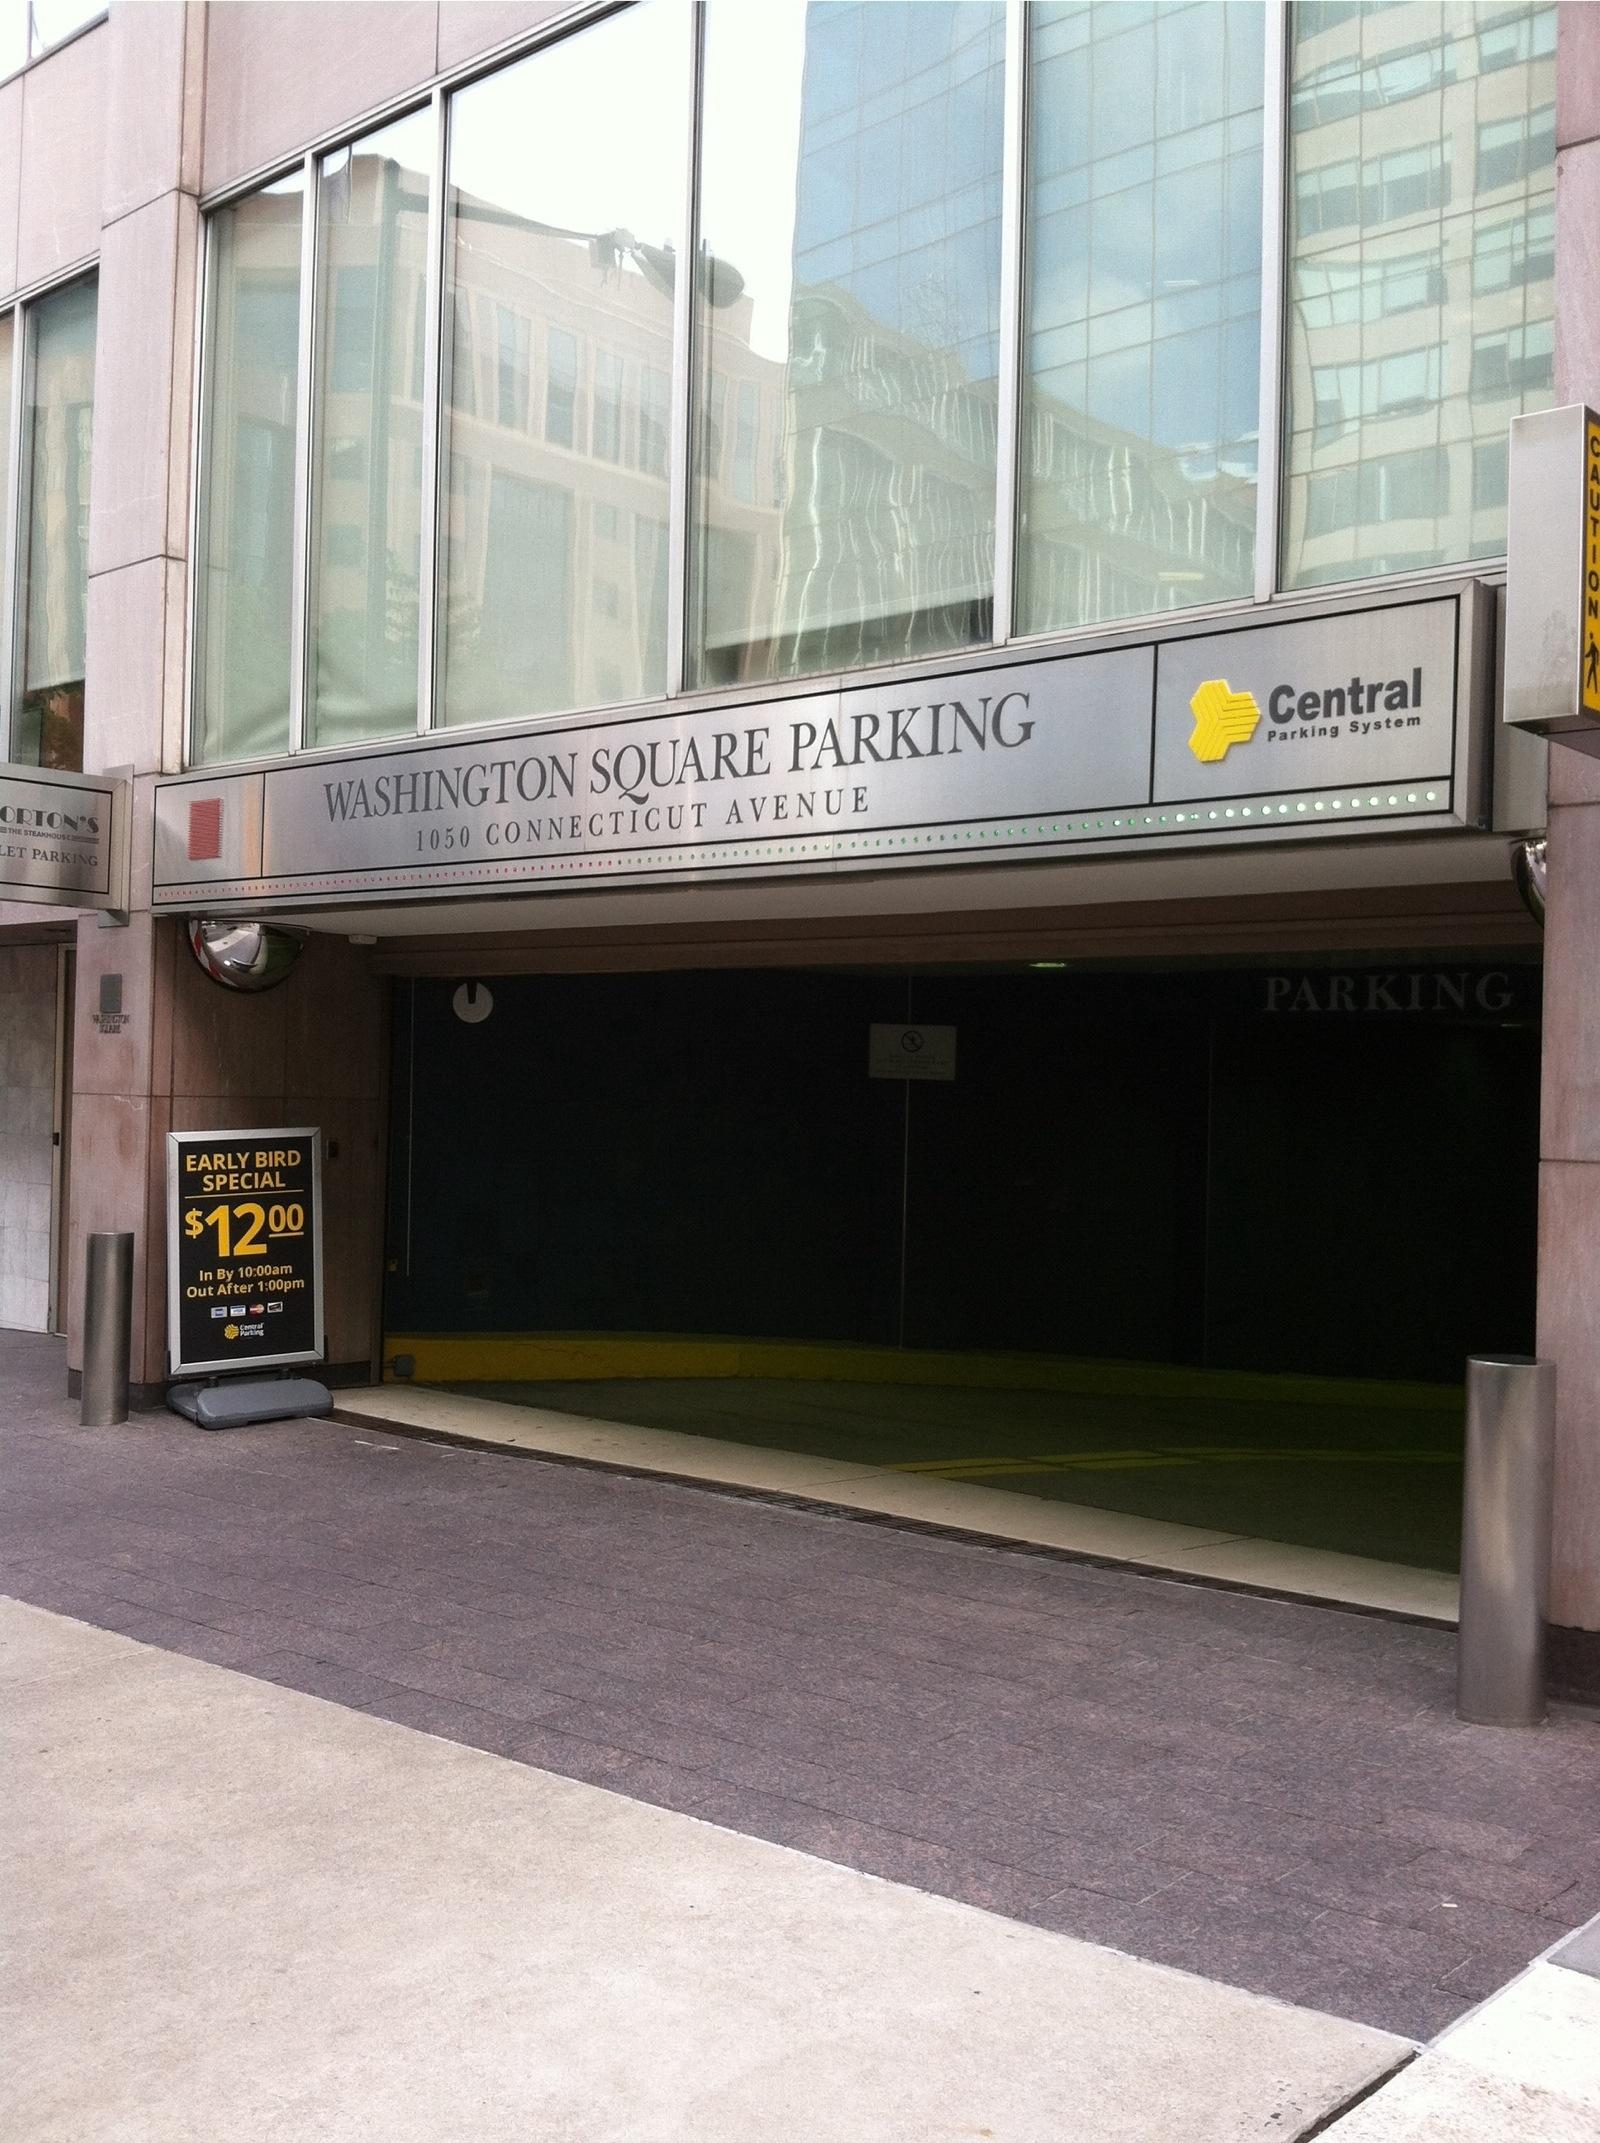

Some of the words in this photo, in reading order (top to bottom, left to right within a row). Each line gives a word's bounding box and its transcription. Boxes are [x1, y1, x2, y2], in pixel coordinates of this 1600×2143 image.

[1588, 435, 1600, 620] CAUTION
[1268, 667, 1423, 725] Central
[1267, 725, 1340, 742] Parking
[1349, 715, 1421, 735] System
[322, 751, 579, 823] WASHINGTON
[590, 727, 771, 804] SQUARE
[788, 691, 1037, 771] PARKING
[415, 826, 472, 852] 1050
[486, 801, 709, 847] CONNECTICUT
[725, 785, 871, 826] AVENUE
[8, 827, 22, 836] THE
[24, 829, 72, 841] STEAKHOUSE
[31, 848, 99, 867] PARKING
[1262, 971, 1515, 1012] PARKING
[186, 1151, 250, 1172] EARLY
[255, 1150, 301, 1169] BIRD
[202, 1172, 286, 1192] SPECIAL
[199, 1270, 213, 1282] In
[216, 1267, 234, 1282] By
[237, 1264, 292, 1279] 10:00am
[186, 1285, 213, 1298] Out
[217, 1282, 254, 1296] After
[257, 1277, 305, 1293] 1:00pm
